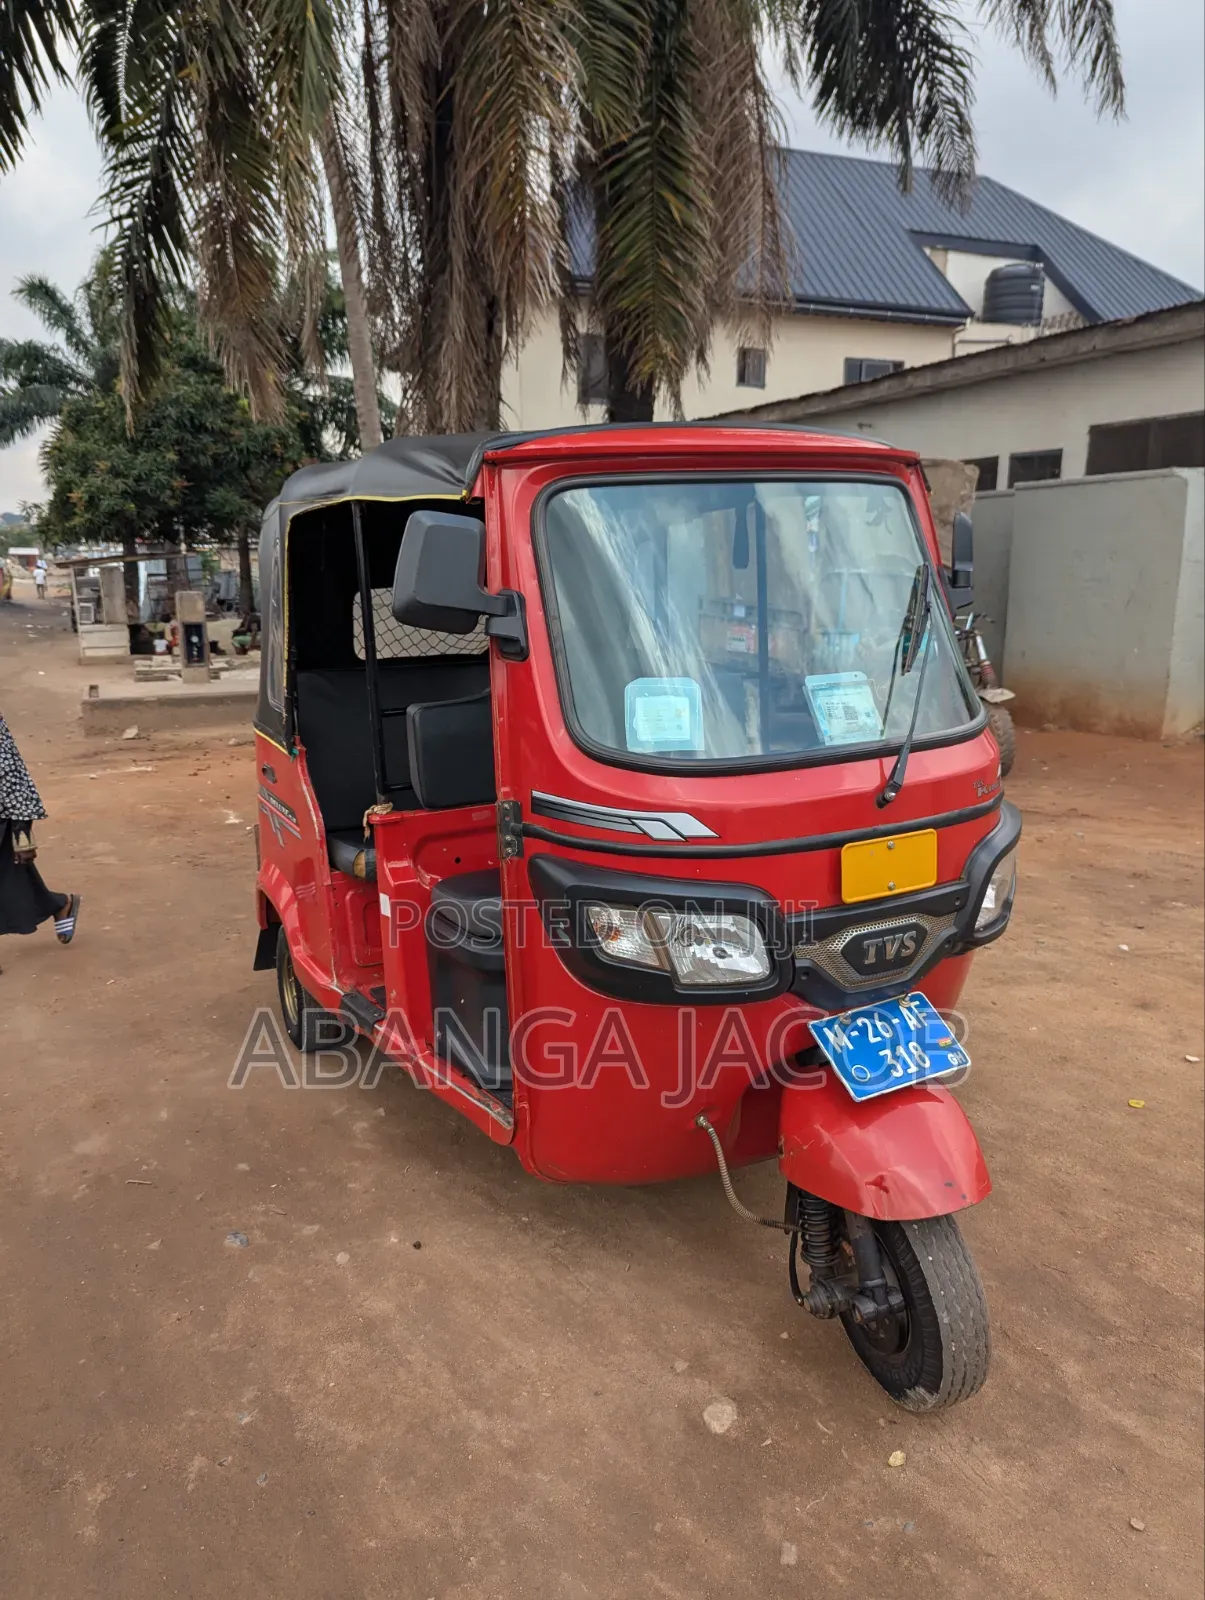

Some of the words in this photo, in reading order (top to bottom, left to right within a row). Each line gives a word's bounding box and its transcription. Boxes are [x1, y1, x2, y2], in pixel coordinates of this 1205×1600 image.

[863, 930, 917, 965] TVS
[823, 1000, 929, 1054] M-26-AF
[879, 1041, 931, 1078] 318
[947, 1050, 966, 1066] GH
